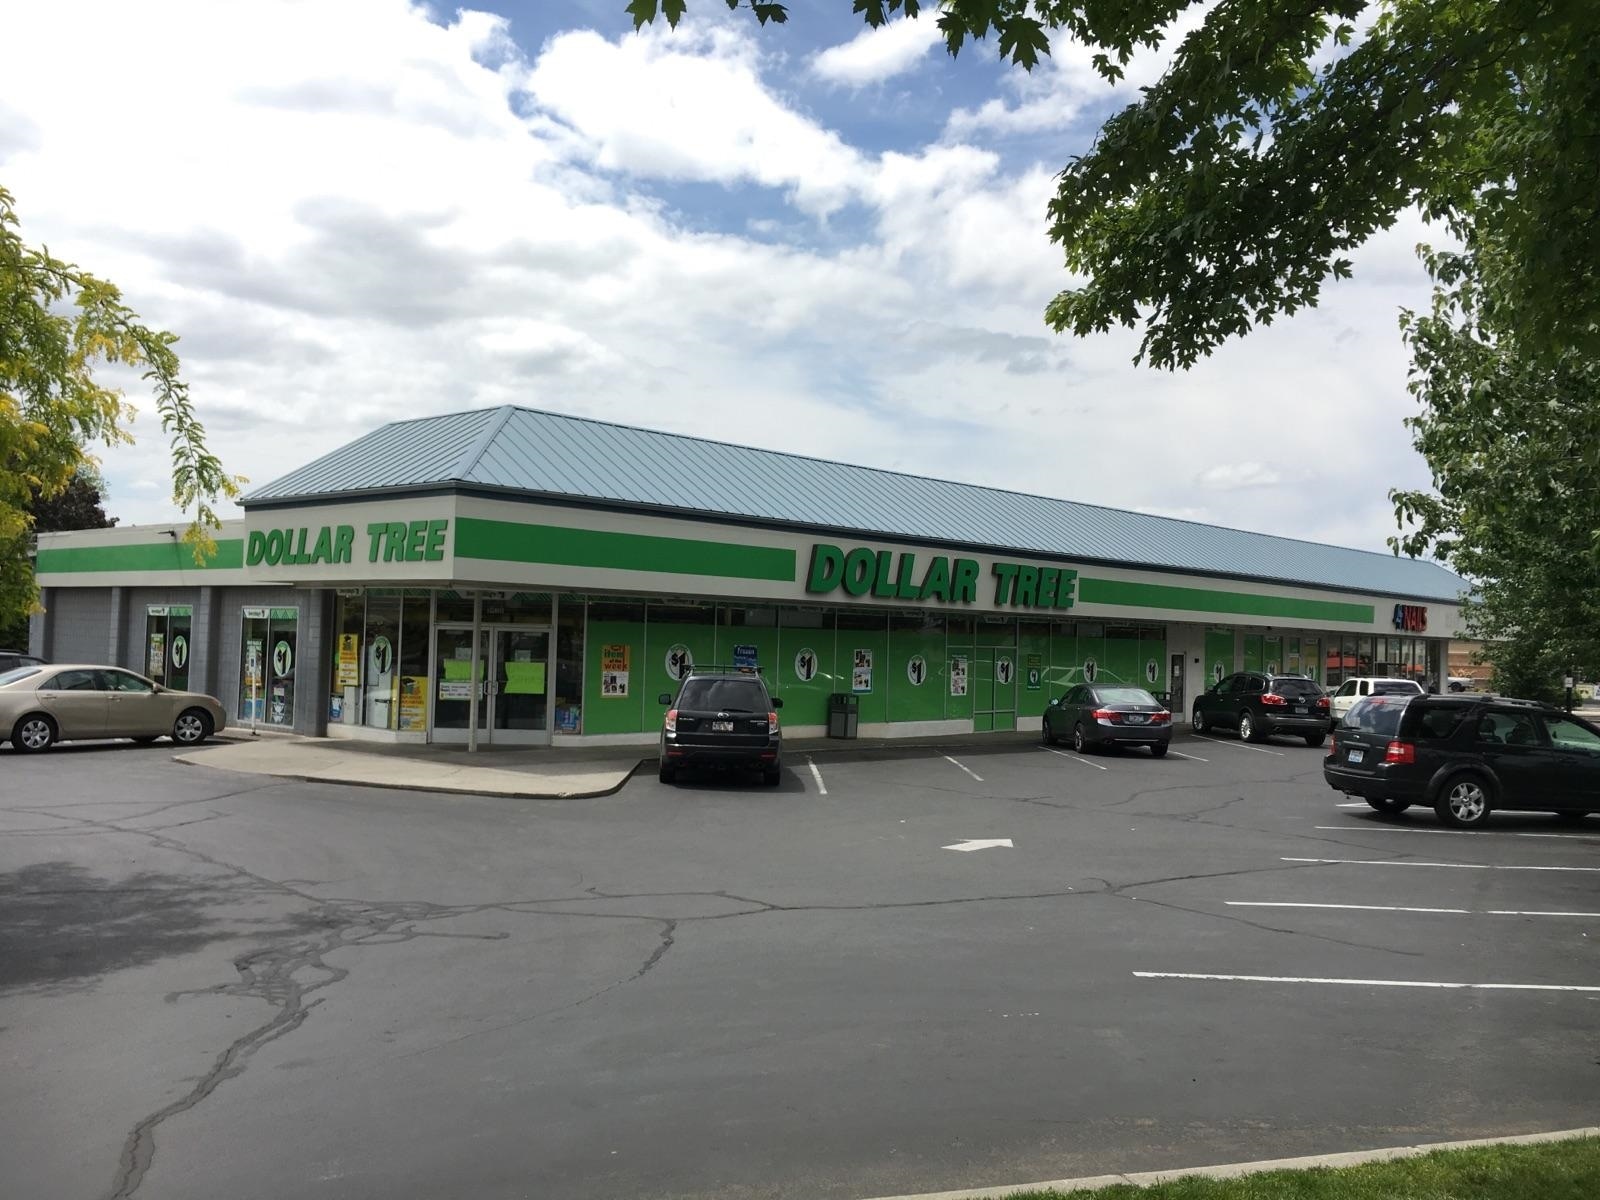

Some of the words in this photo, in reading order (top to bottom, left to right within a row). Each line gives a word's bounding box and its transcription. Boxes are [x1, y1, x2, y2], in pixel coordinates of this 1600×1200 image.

[246, 525, 355, 566] DOLLAR
[367, 520, 449, 563] TREE
[806, 543, 981, 604] DOLLAR
[991, 562, 1079, 610] TREE
[275, 649, 287, 674] $1
[604, 663, 627, 671] week
[799, 655, 813, 680] $1
[911, 662, 922, 684] $1
[1000, 662, 1009, 683] $1
[1086, 663, 1095, 682] $1
